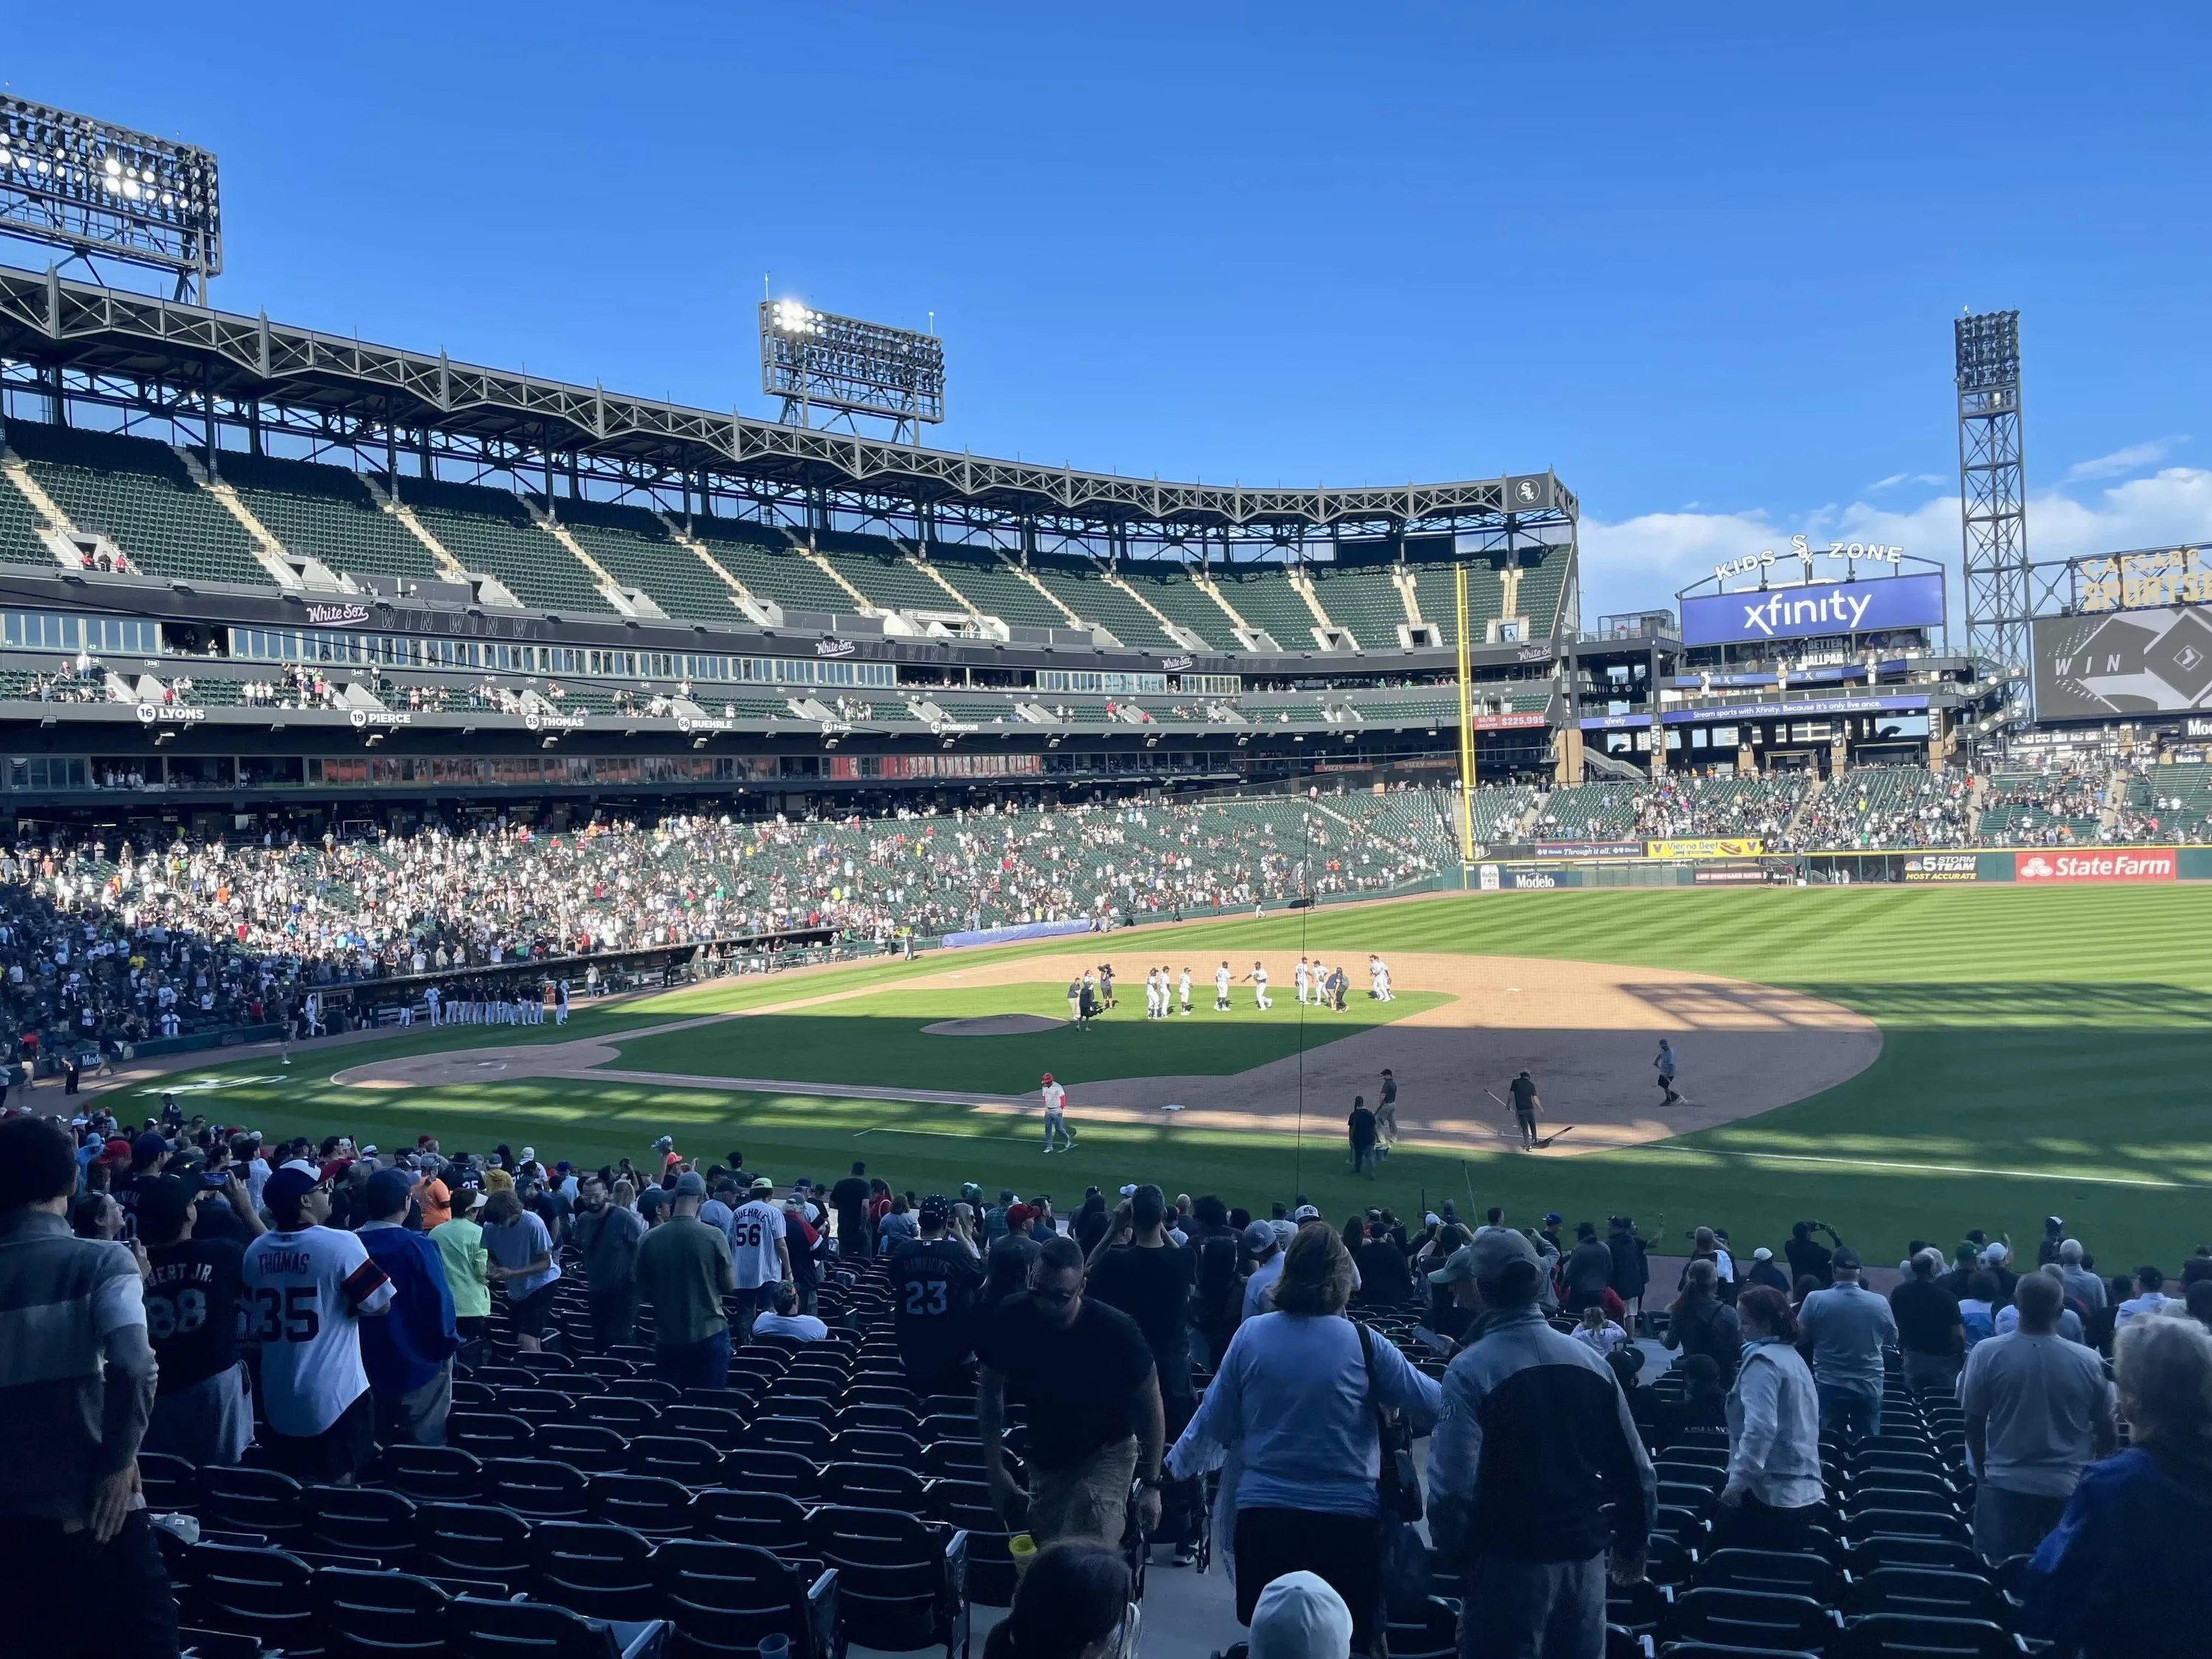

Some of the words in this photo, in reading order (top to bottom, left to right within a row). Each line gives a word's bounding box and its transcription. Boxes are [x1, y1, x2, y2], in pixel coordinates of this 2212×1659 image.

[1714, 549, 1775, 581] KIDS
[1828, 542, 1904, 563] ZONE
[2082, 549, 2200, 577] CAESARS
[306, 605, 342, 622] White
[344, 603, 368, 619] Sox
[1744, 589, 1872, 635] xfinity
[815, 641, 838, 654] White
[1807, 639, 1843, 650] BETTER
[1517, 649, 1541, 661] White
[140, 709, 153, 717] 16
[159, 708, 205, 720] LYONS
[1756, 706, 1781, 714] Xfinity.
[1829, 702, 1845, 710] only
[352, 714, 364, 722] 19
[369, 714, 411, 724] PIERCE
[541, 717, 584, 727] THOMAS
[692, 720, 732, 728] BUEHRLE
[1501, 715, 1545, 726] $225,995
[1604, 717, 1626, 726] xfinity
[2176, 755, 2201, 763] Modelo
[1563, 848, 1592, 856] Through
[1923, 857, 1935, 872] 5
[1936, 863, 1975, 871] TEAM
[2056, 857, 2112, 876] State
[2115, 856, 2171, 875] Farm
[1516, 874, 1555, 888] Modelo
[734, 1208, 768, 1223] BUEHRLE
[737, 1223, 761, 1247] 56
[258, 1250, 310, 1275] THOMAS
[189, 1263, 212, 1282] JR.
[905, 1281, 947, 1315] 23
[147, 1288, 206, 1338] 88
[256, 1286, 319, 1343] 35
